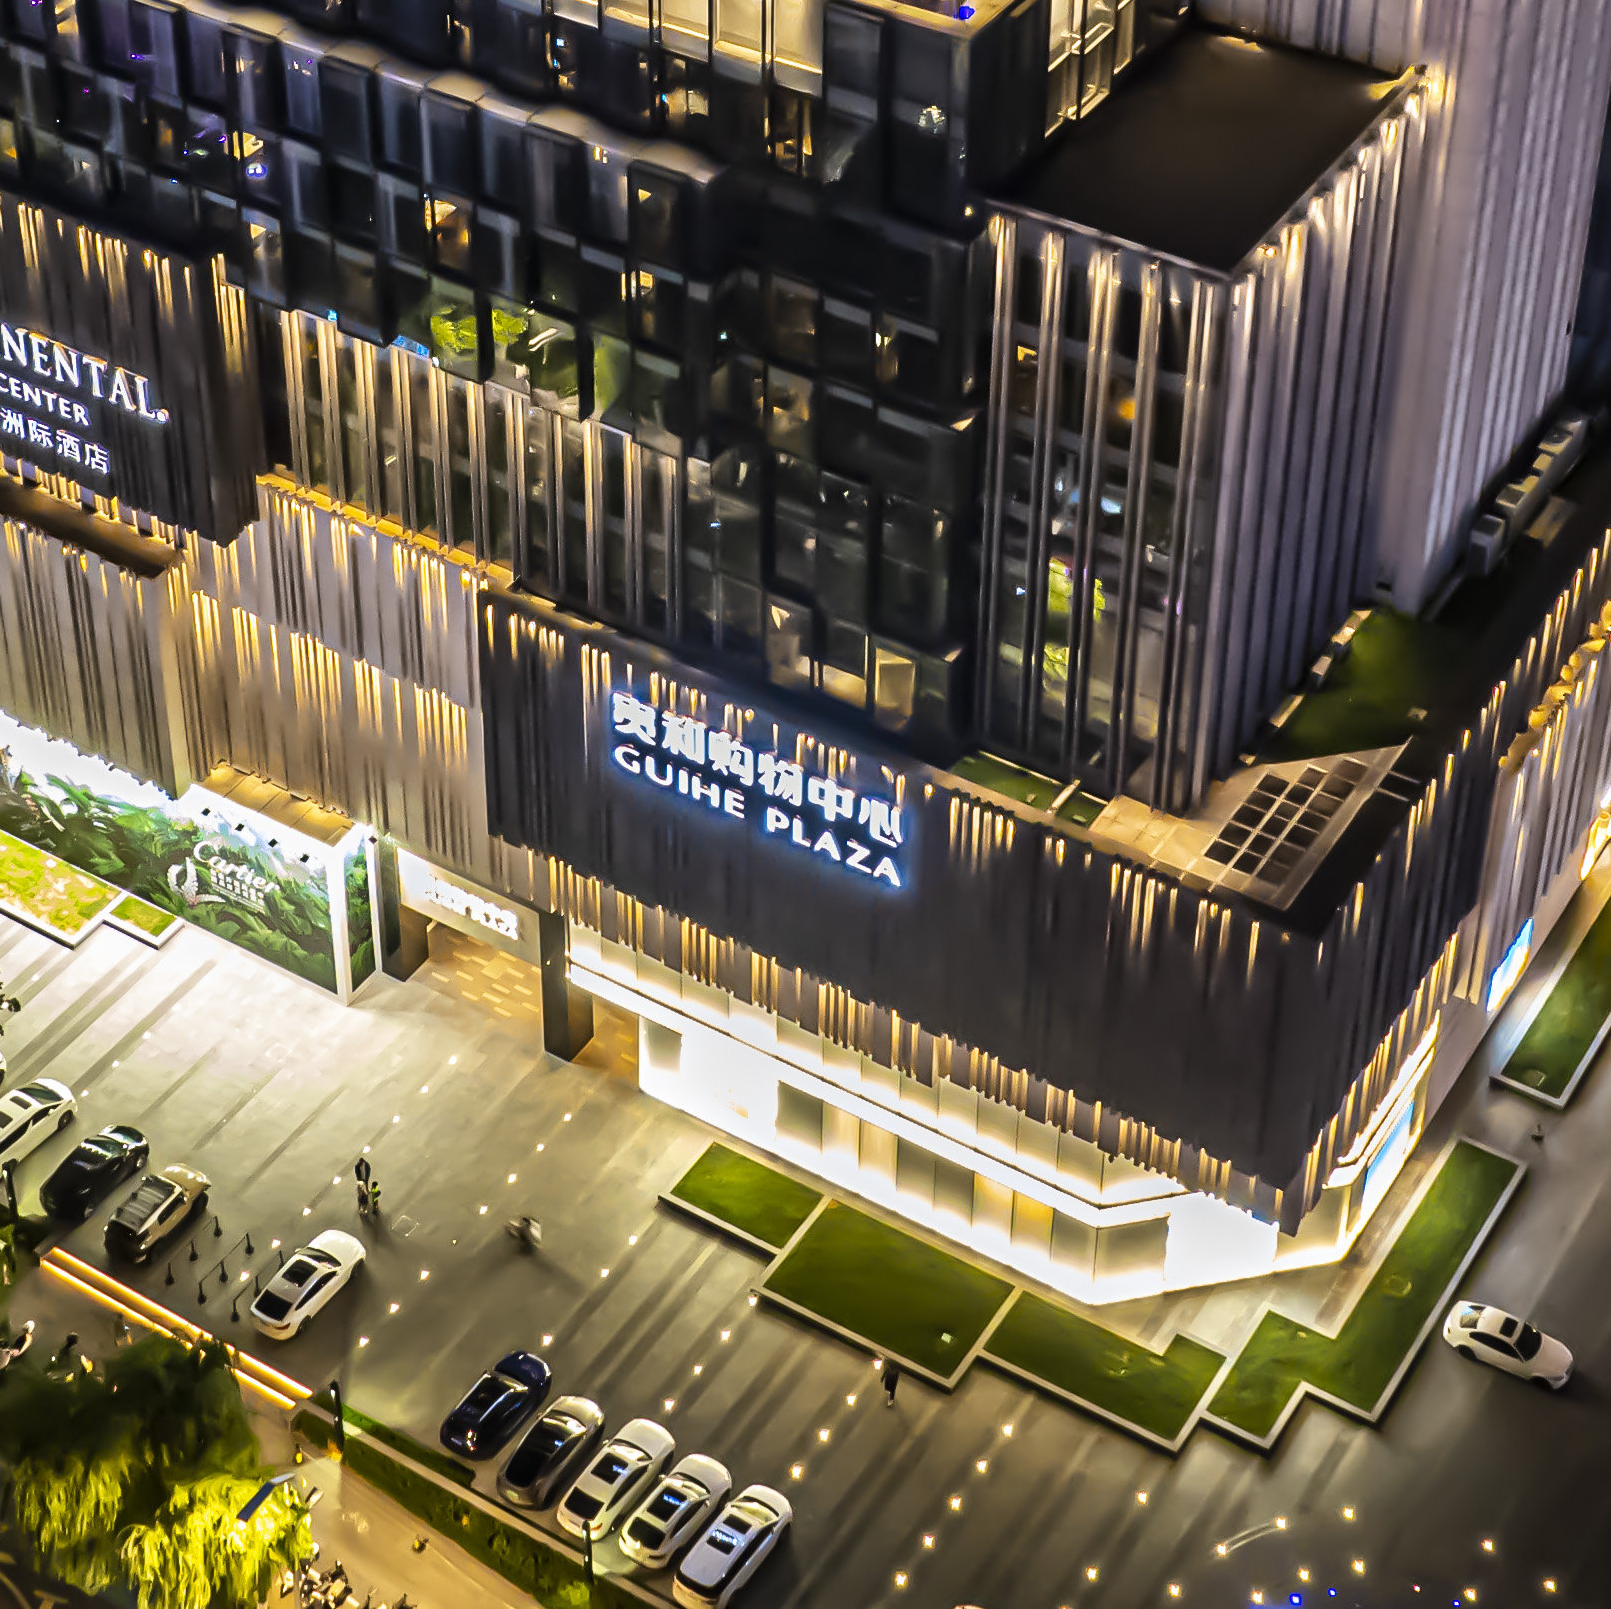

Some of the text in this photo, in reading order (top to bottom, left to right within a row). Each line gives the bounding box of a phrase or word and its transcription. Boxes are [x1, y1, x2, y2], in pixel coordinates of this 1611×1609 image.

[612, 691, 903, 847] 贵和购物中心
[613, 743, 902, 887] GUIHE PLAZA
[193, 840, 281, 893] Cartier
